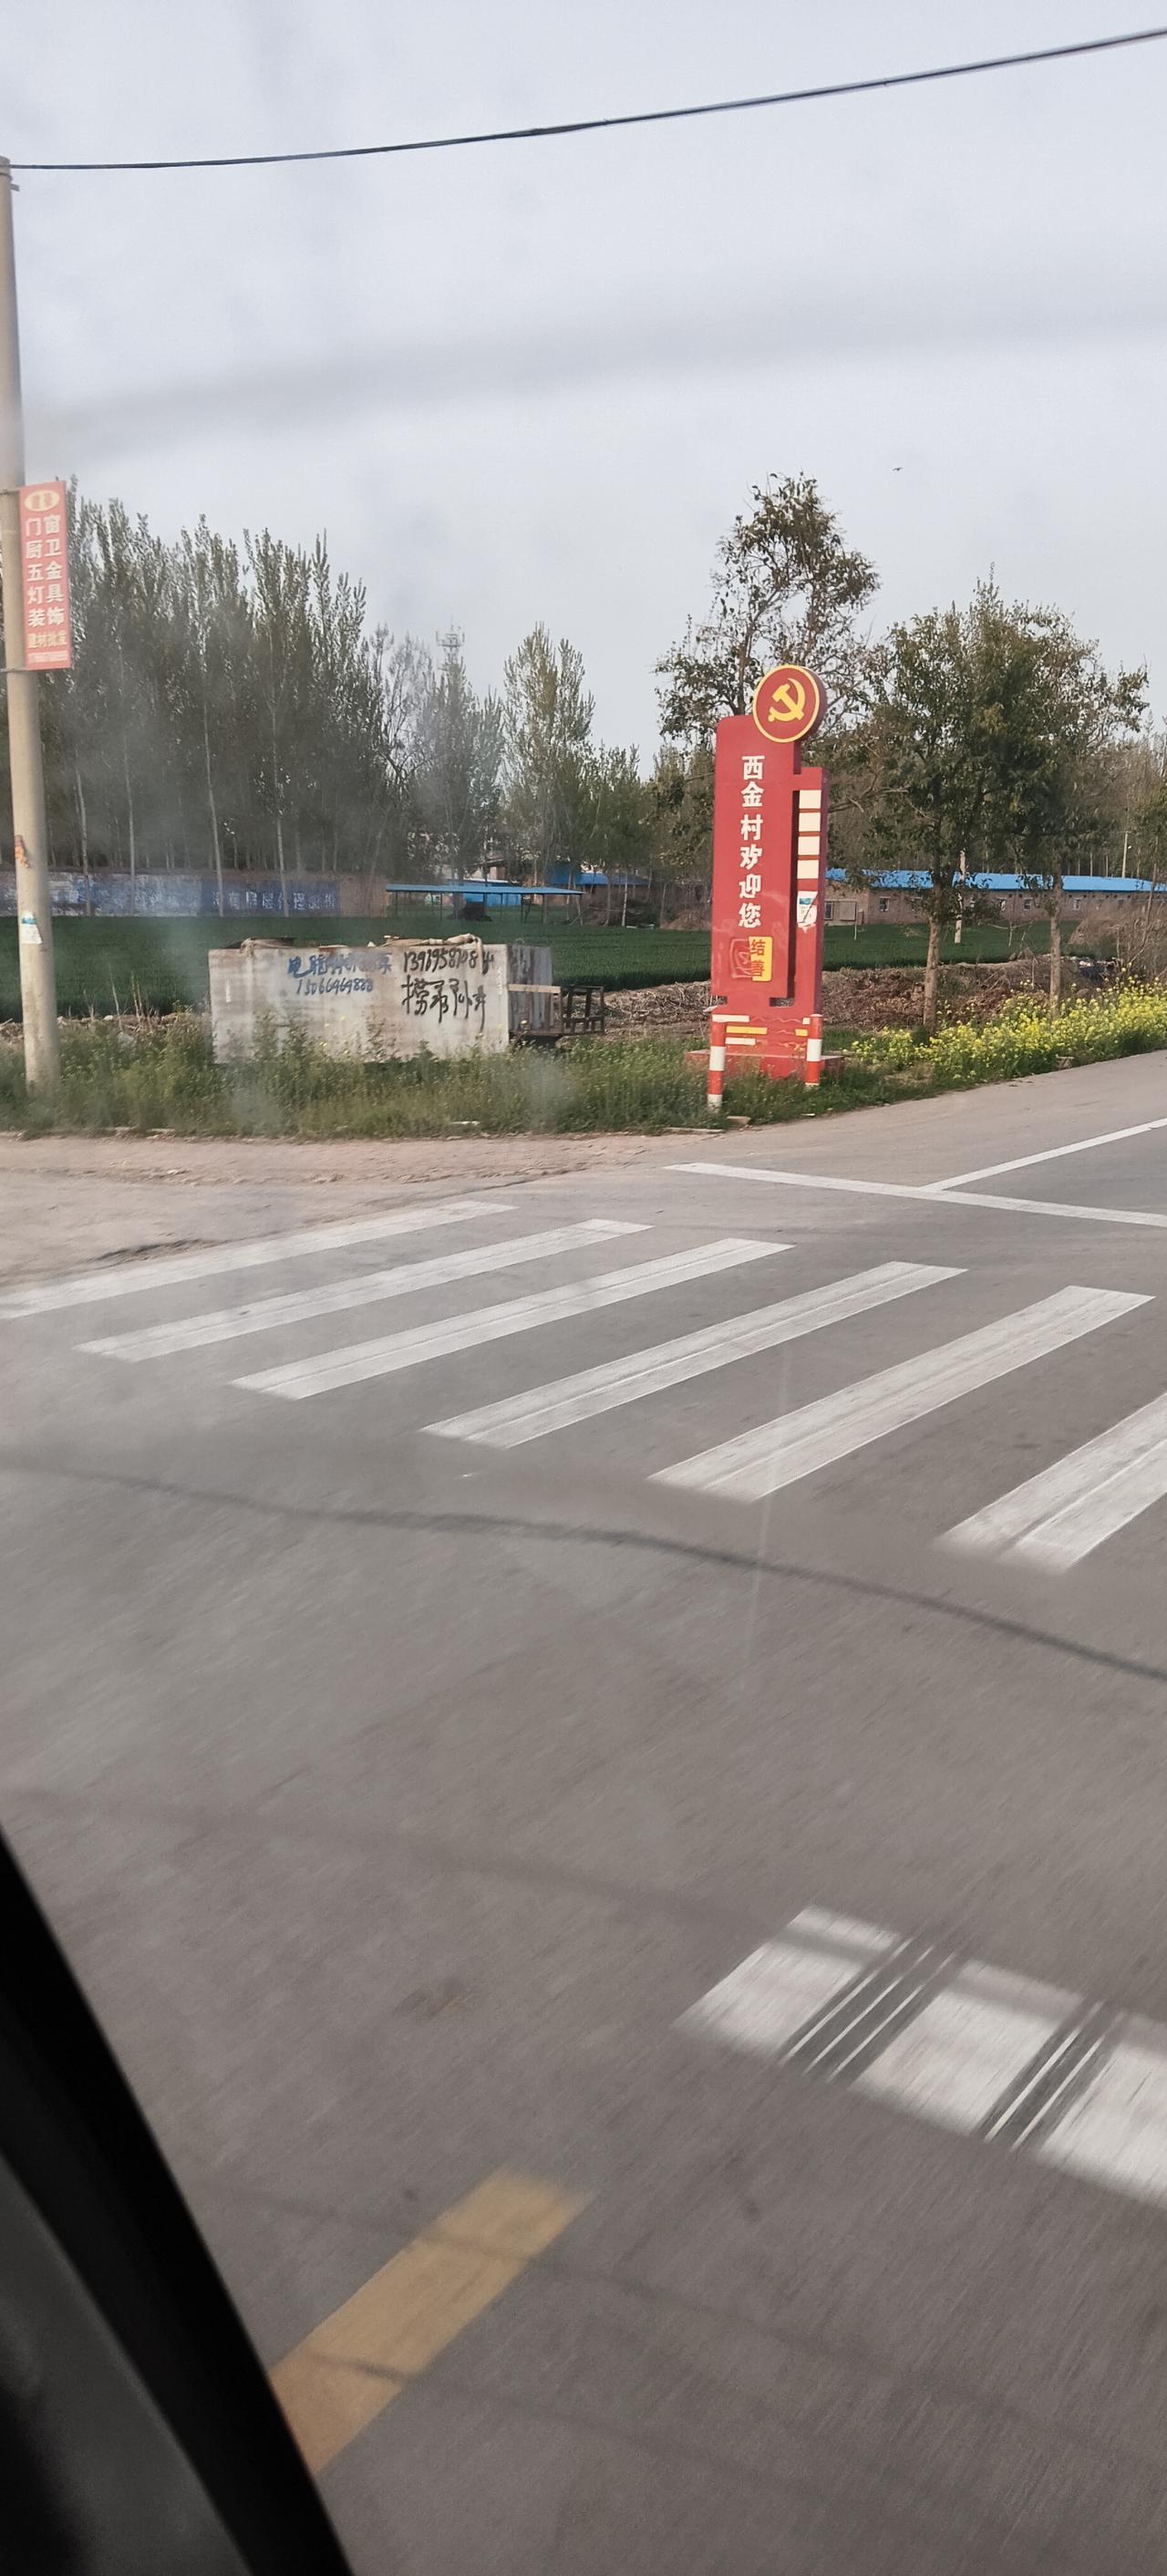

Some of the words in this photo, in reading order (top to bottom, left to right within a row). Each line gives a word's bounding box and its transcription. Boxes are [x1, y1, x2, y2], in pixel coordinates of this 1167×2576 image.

[738, 755, 766, 928] 西金村欢迎您
